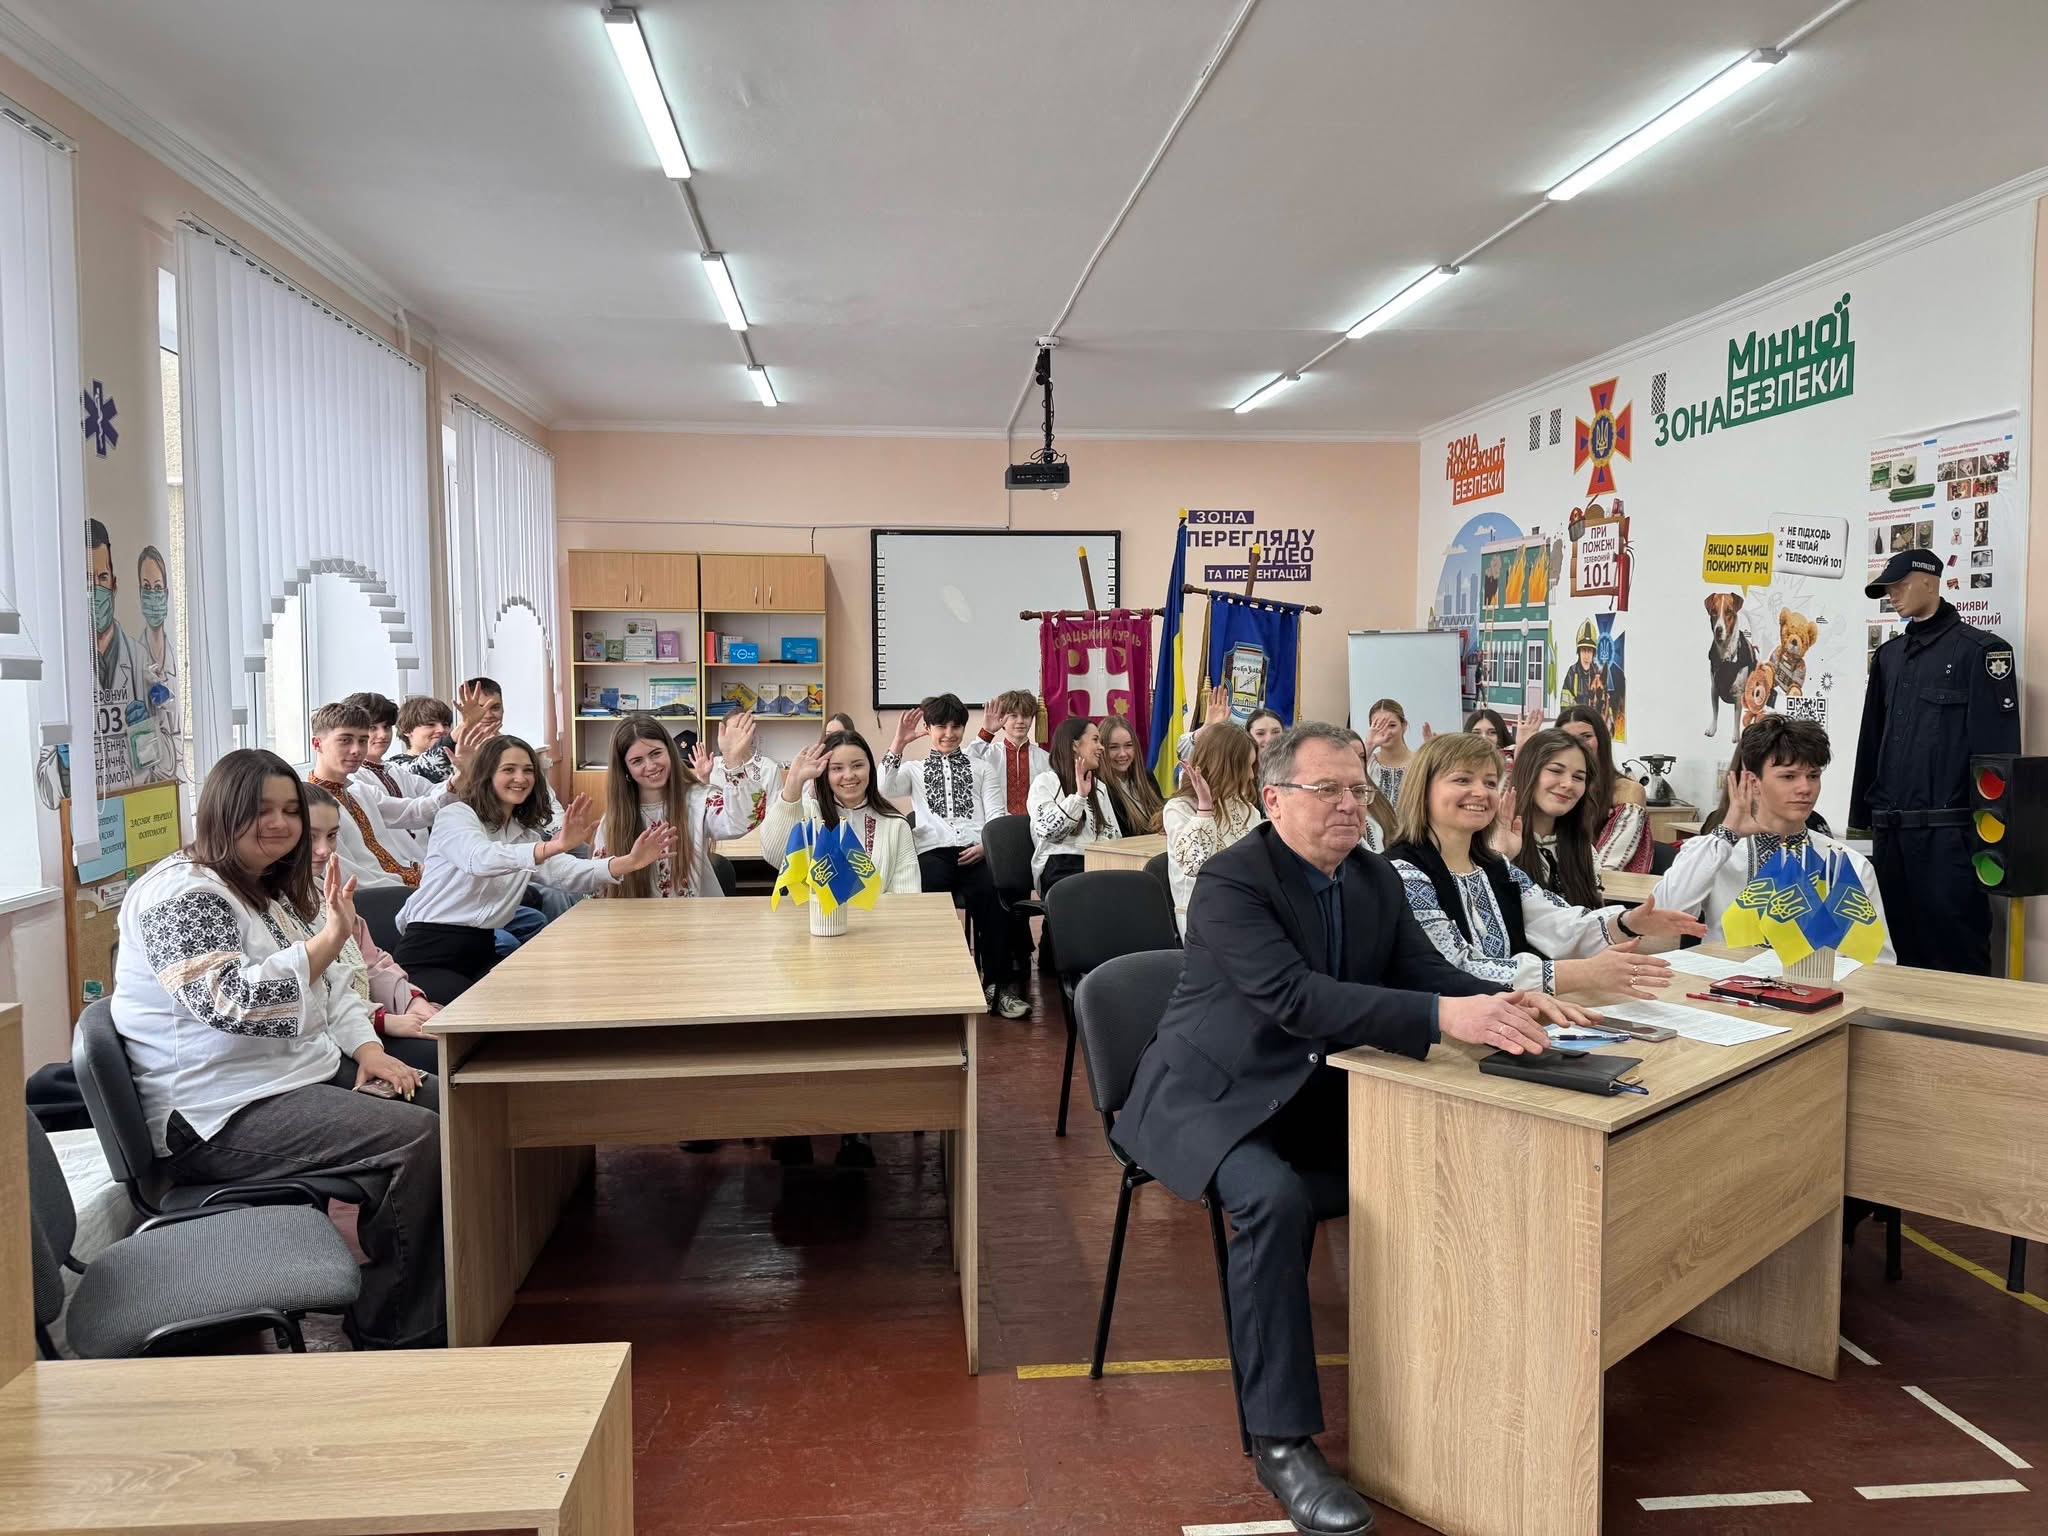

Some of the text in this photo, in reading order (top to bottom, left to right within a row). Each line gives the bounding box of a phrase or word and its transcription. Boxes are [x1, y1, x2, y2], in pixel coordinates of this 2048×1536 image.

[1729, 292, 1851, 381] МІННОЇ
[1655, 353, 1848, 447] ЗОНА БЕЗПЕКИ
[1447, 433, 1479, 461] ЗОНА
[1446, 437, 1506, 480] ПОЖЕЖНОЇ
[1455, 468, 1502, 501] БЕЗПЕКИ
[1196, 511, 1247, 524] ЗОНА
[1187, 528, 1315, 548] ПЕРЕГЛЯДУ
[1591, 525, 1607, 539] ПРИ
[1787, 526, 1831, 540] НЕ ПІДХОДЬ
[1582, 538, 1615, 554] ПОЖЕЖІ
[1707, 544, 1769, 557] ЯКЩО БАЧИШ
[1786, 540, 1819, 552] НЕ ЧІПАЙ
[1583, 552, 1611, 564] ТЕЛЕФОНУЙ
[1785, 552, 1842, 569] ТЕЛЕФОНУЙ 101
[1207, 566, 1307, 581] ТА ПРЕЕНТАЦІЙ
[1583, 562, 1611, 588] 101
[1706, 560, 1769, 574] ПОКИНУТУ РІЧ
[1956, 601, 1989, 611] ВИЯВИ
[1054, 627, 1110, 649] ОЗАЦЬКИЙ
[94, 706, 123, 734] 03
[95, 755, 127, 772] ЕДИЧНА
